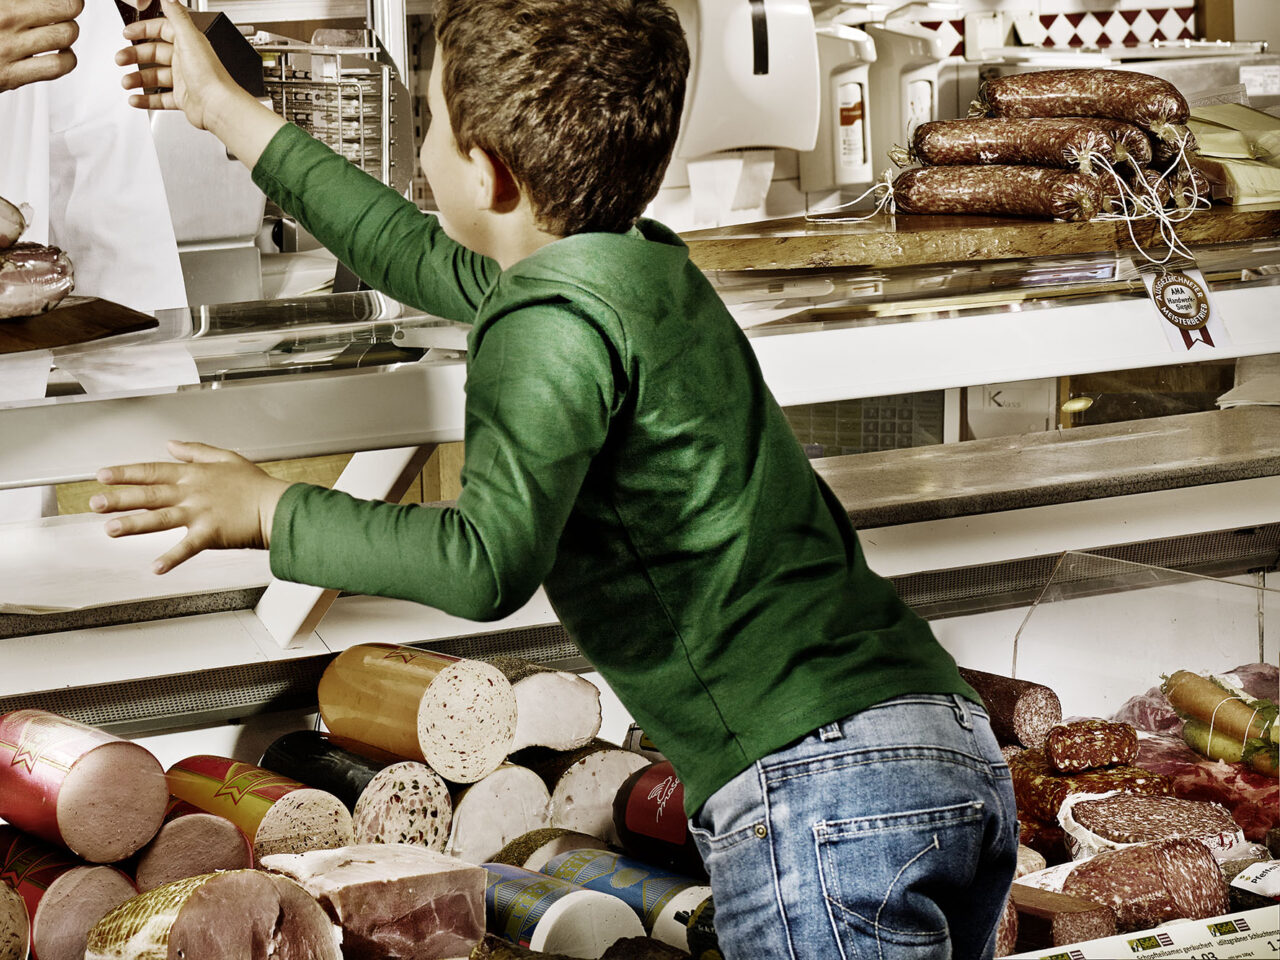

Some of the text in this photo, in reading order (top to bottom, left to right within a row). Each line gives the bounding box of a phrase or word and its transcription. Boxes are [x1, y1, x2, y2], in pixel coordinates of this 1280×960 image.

[1155, 275, 1204, 301] AUSGEZEICHNETER
[1167, 296, 1195, 304] Handwerk-
[1160, 303, 1208, 326] MEISTERBETRIEB
